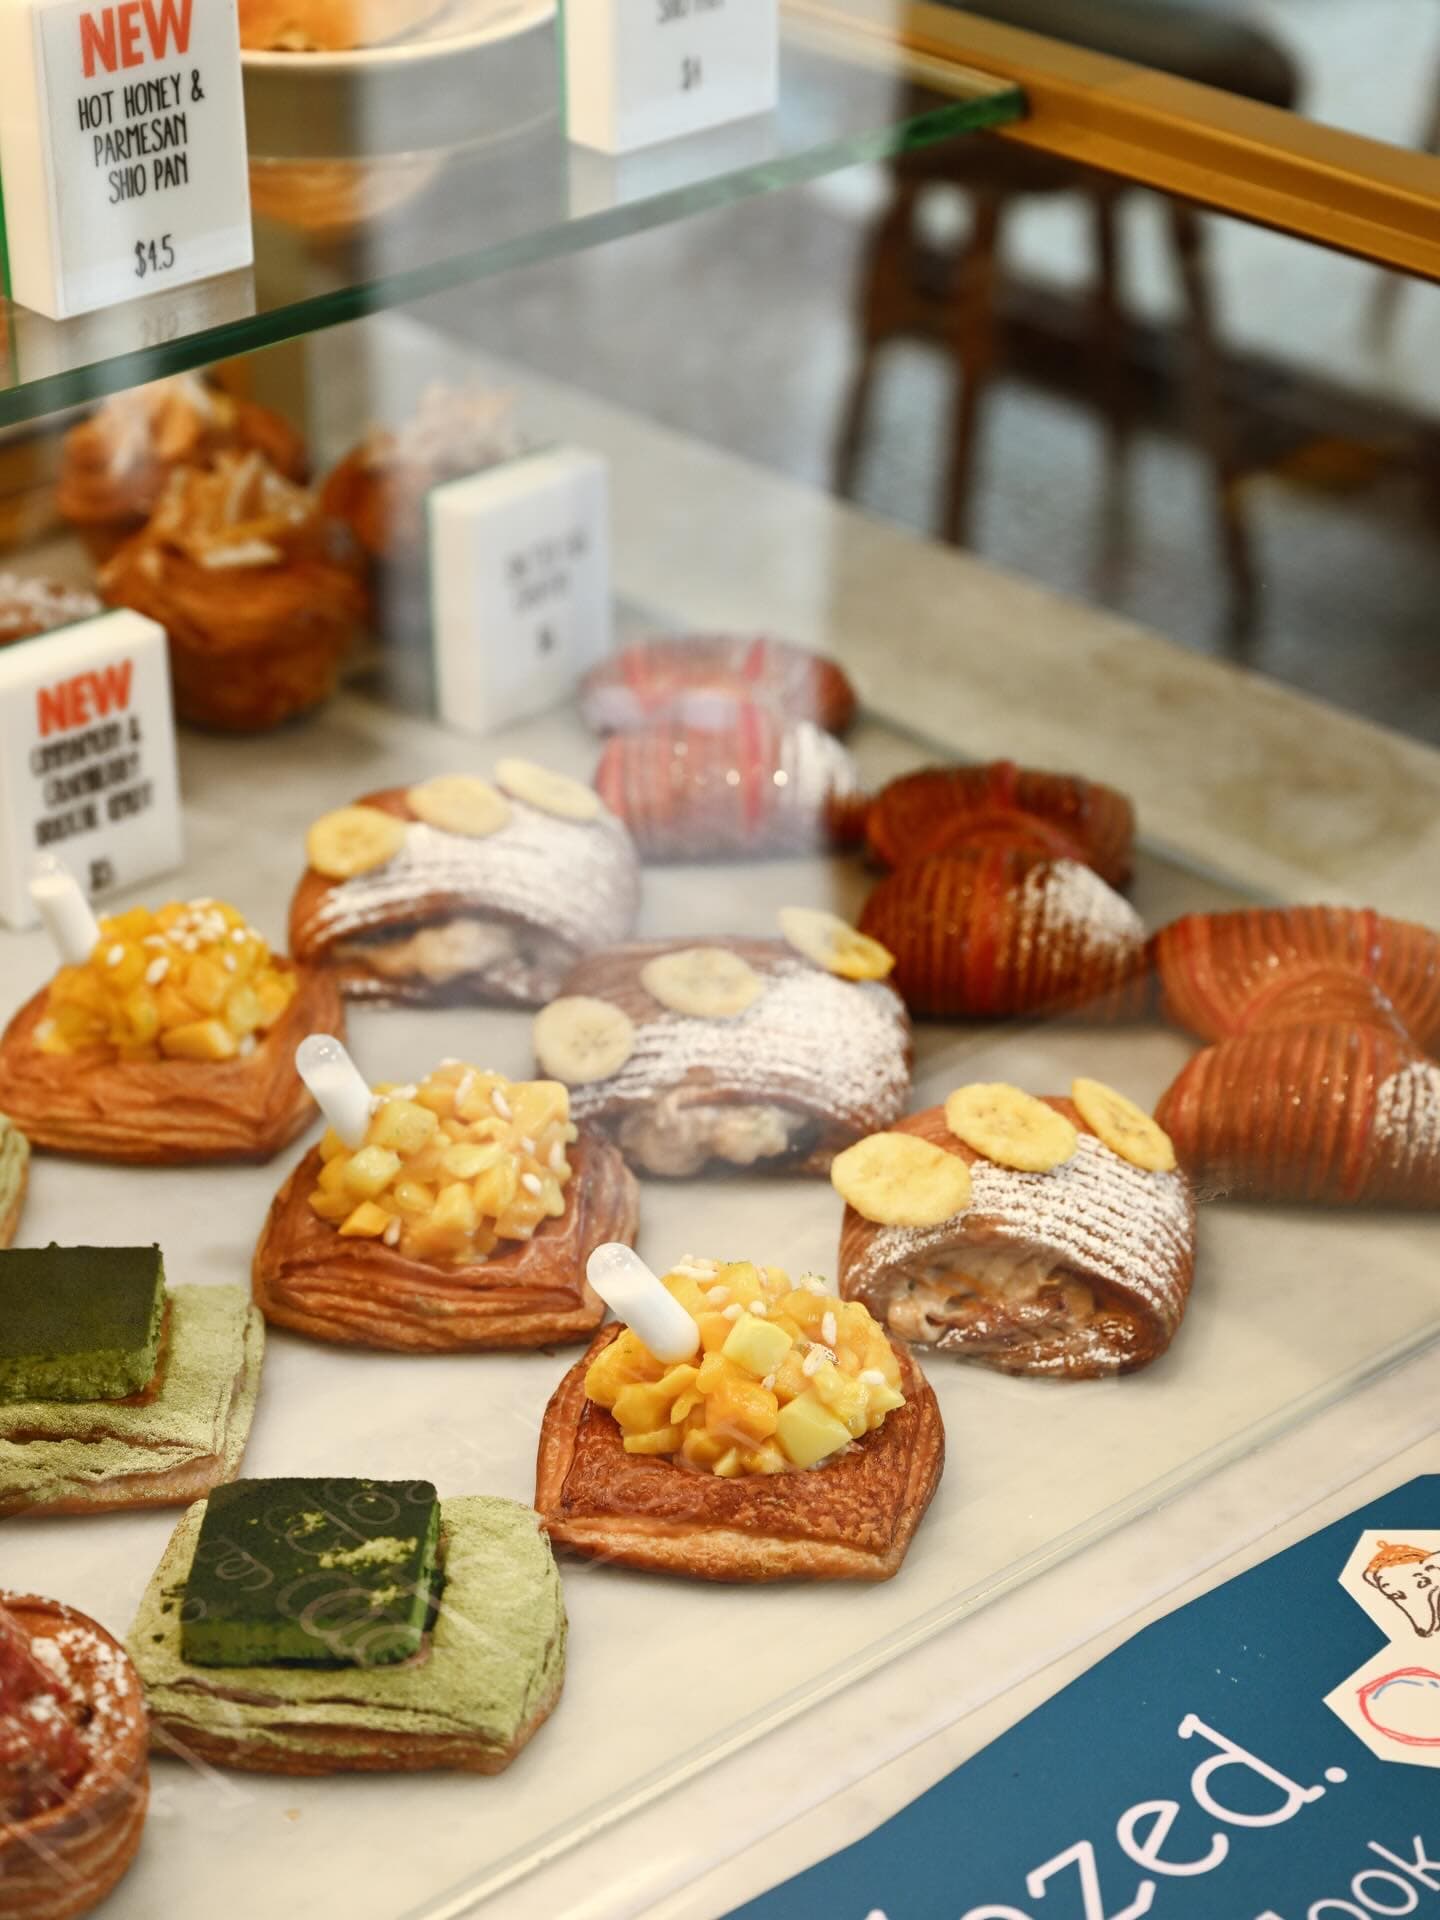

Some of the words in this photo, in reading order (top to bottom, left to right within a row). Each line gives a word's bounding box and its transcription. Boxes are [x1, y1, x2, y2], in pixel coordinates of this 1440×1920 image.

[79, 0, 192, 78] NEW
[77, 90, 115, 131] HOT
[124, 73, 182, 119] HONEY
[191, 69, 205, 102] &
[94, 112, 188, 167] PARMESAN
[109, 164, 147, 204] SHIO
[155, 152, 189, 191] PAN
[135, 234, 175, 278] $4.5
[36, 657, 133, 738] NEW
